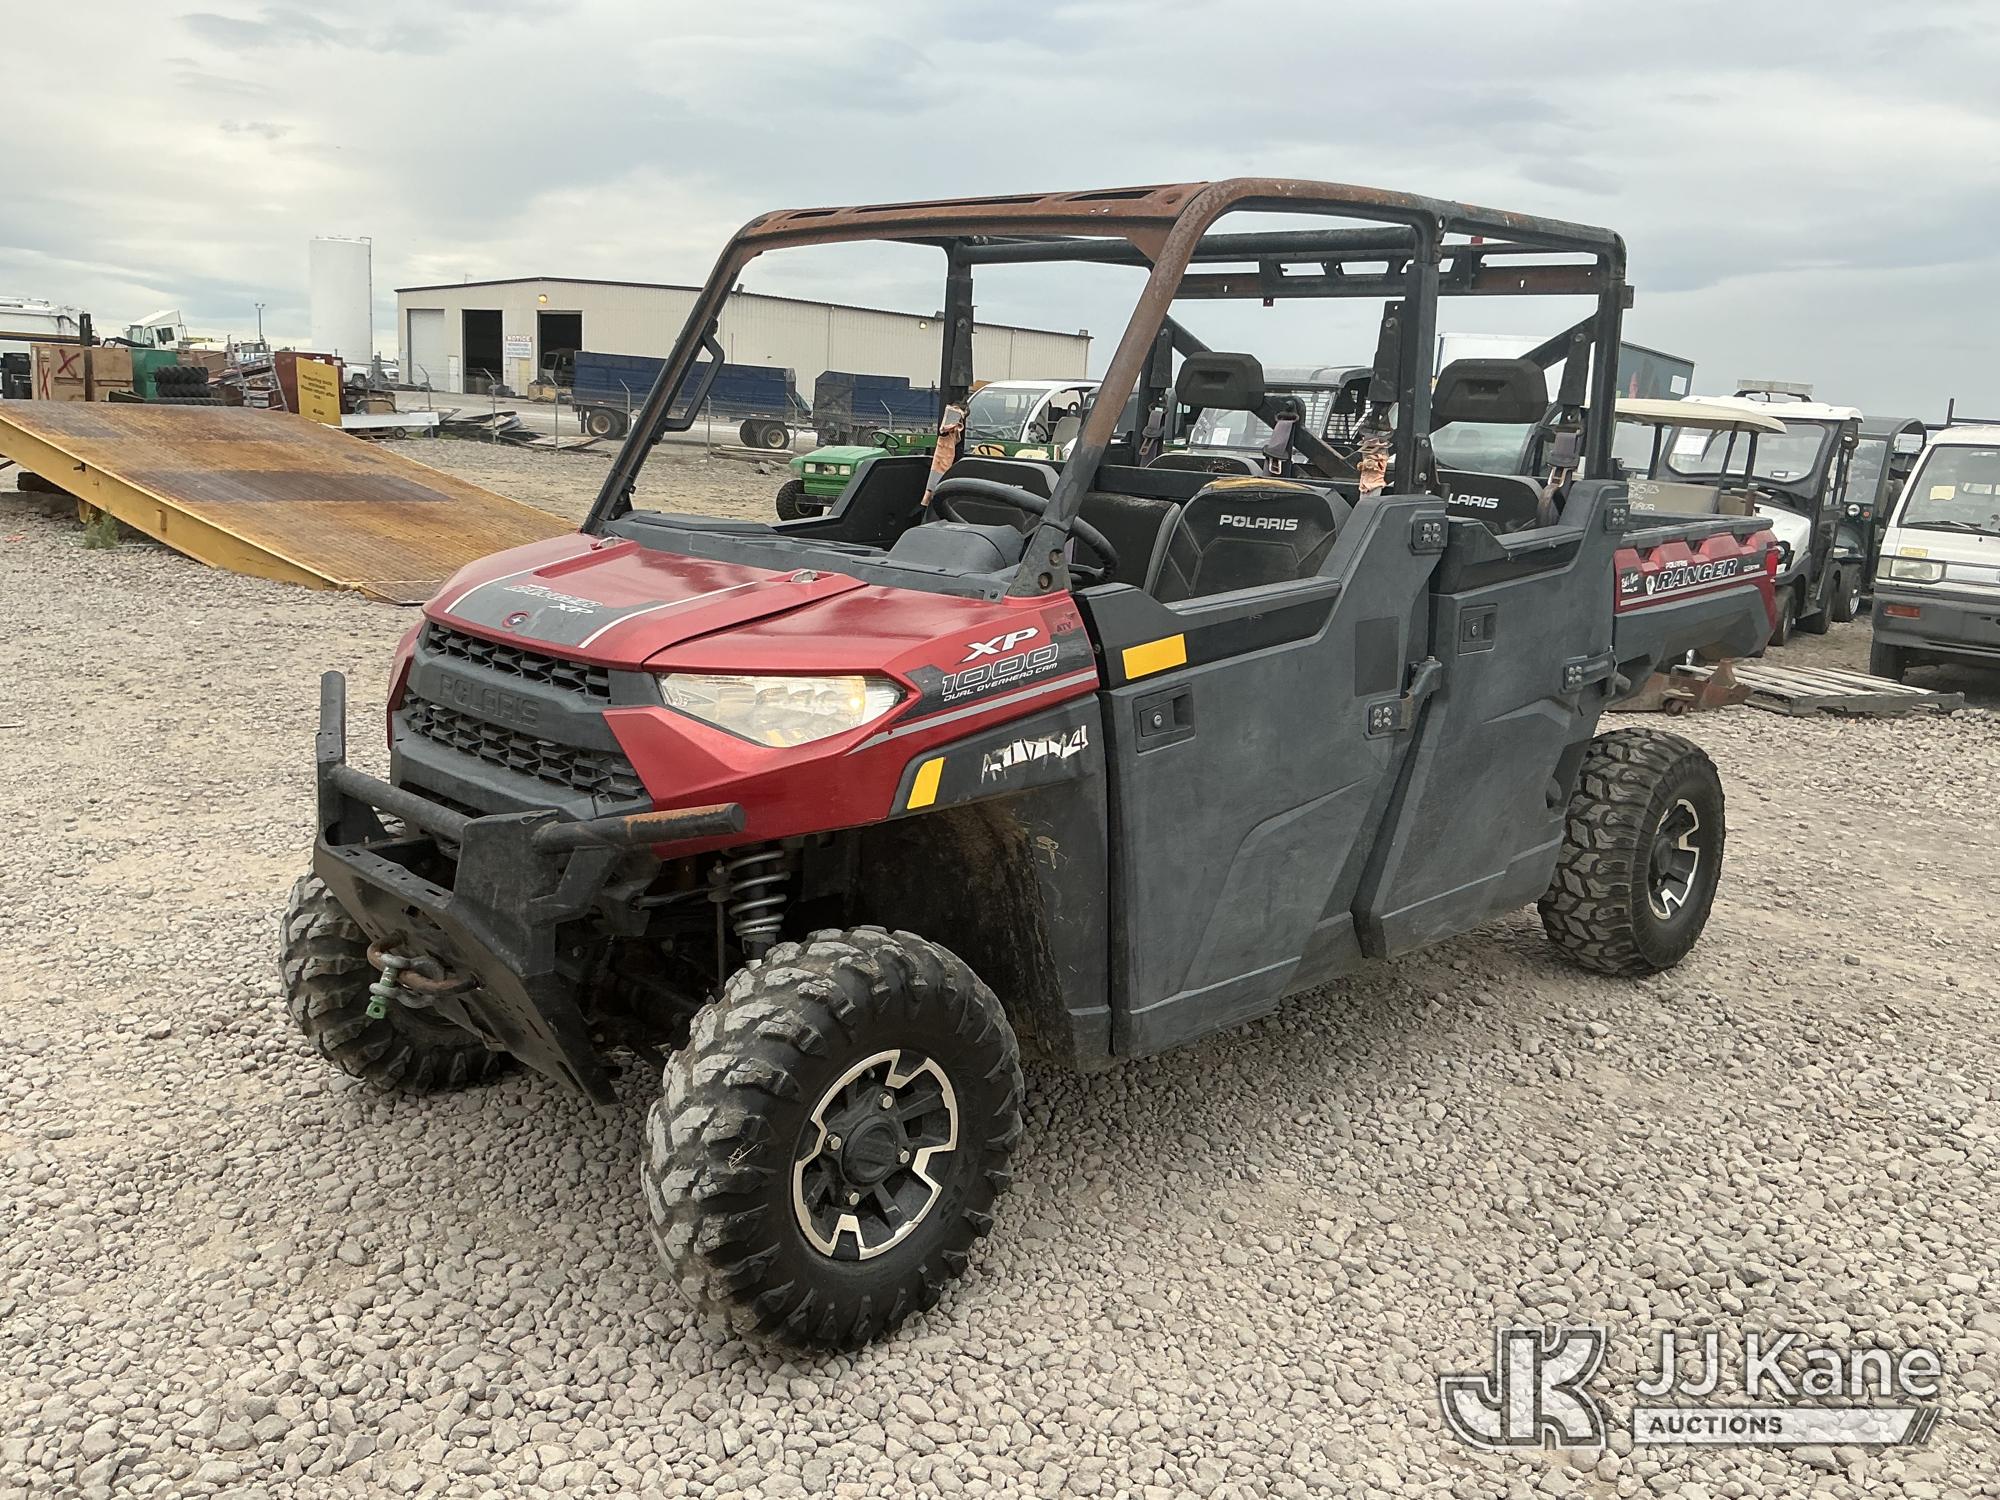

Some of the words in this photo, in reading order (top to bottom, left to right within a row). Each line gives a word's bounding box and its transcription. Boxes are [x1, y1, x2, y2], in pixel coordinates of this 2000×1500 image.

[1448, 493, 1500, 509] LARIS
[1219, 514, 1299, 531] POLARIS
[1655, 558, 1738, 592] RANGER
[1665, 560, 1688, 569] POLARIS
[547, 603, 594, 614] XP
[1056, 621, 1072, 633] ATV
[960, 627, 1040, 663] XP
[942, 643, 1059, 696] 1000
[943, 689, 975, 702] DUAL
[977, 670, 1034, 691] OVERHEAD
[1035, 662, 1058, 675] CAM
[440, 673, 540, 729] POLARIS
